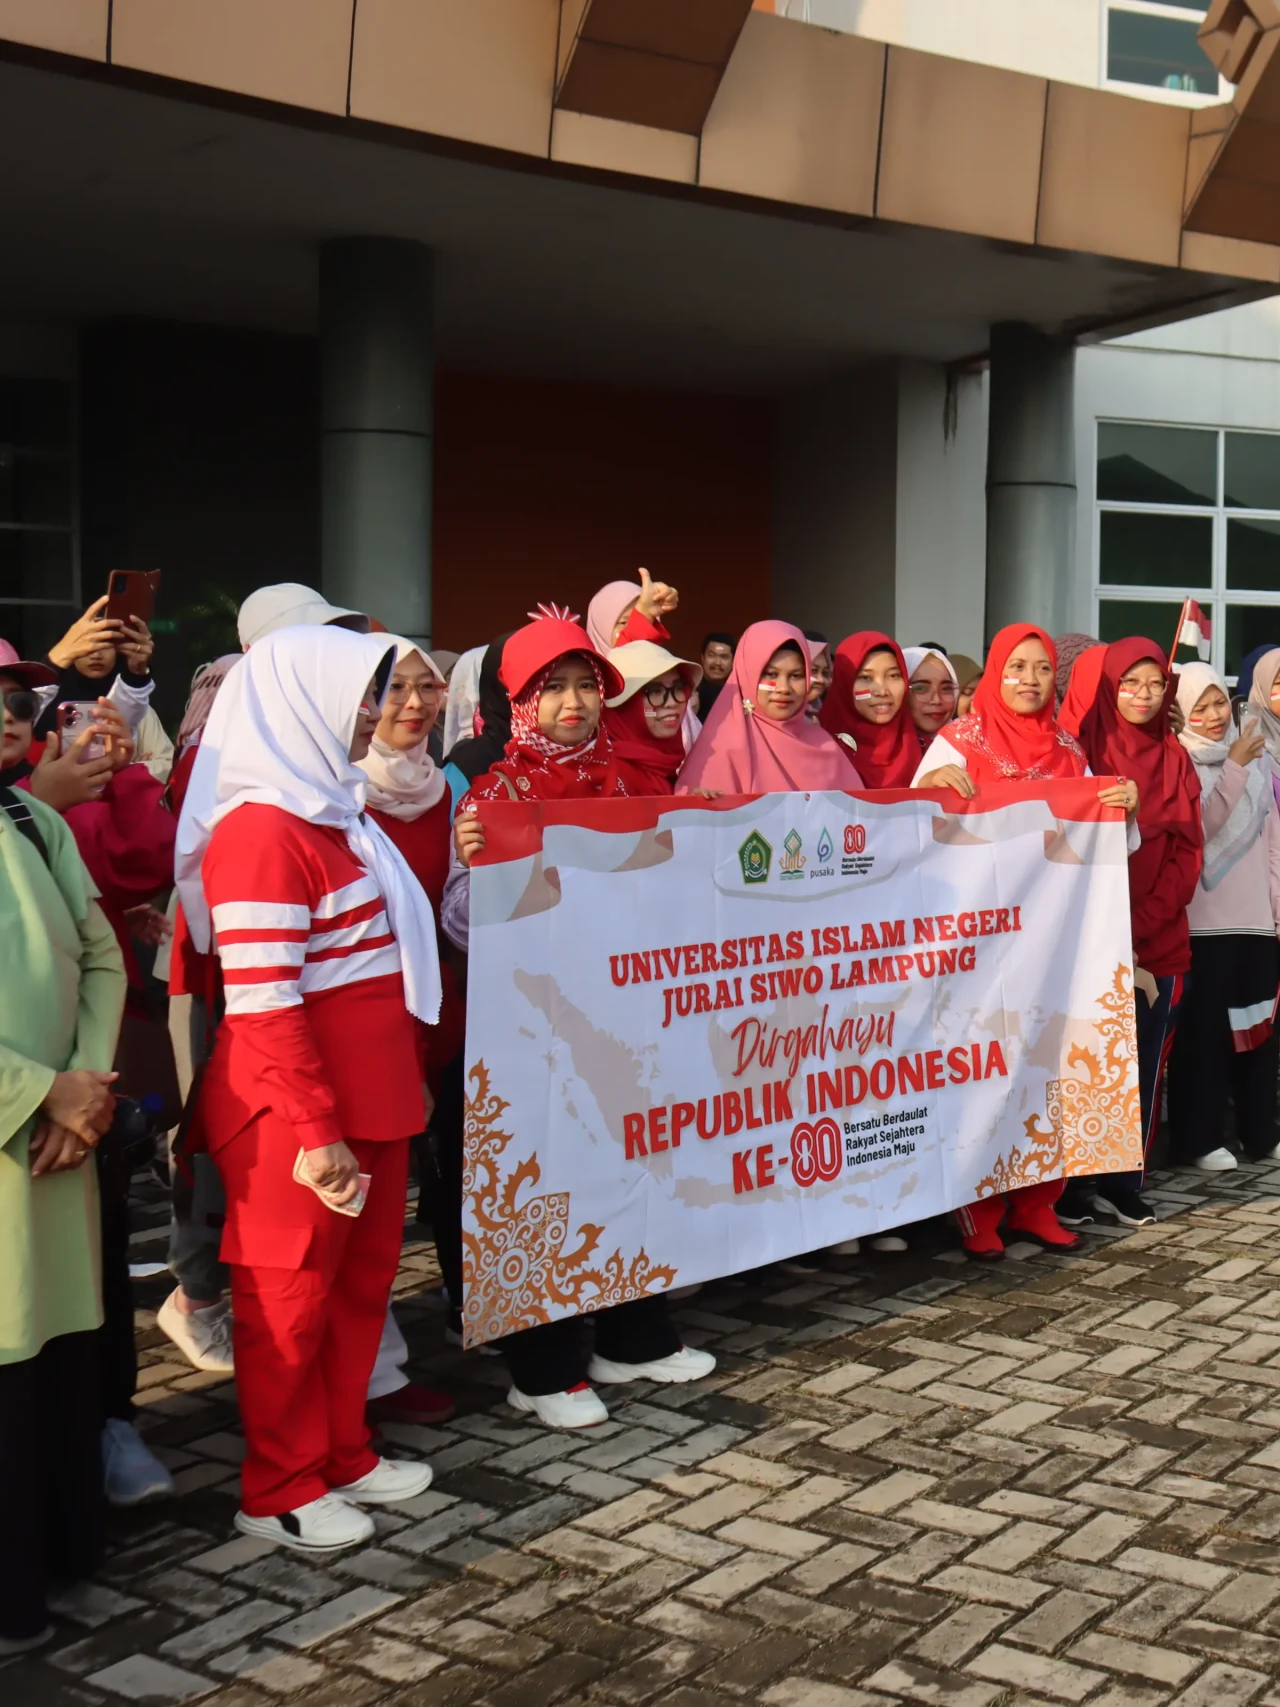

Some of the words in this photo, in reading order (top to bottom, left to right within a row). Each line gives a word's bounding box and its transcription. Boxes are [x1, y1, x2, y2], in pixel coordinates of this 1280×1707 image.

[844, 824, 866, 854] 80
[810, 867, 835, 879] pusaka
[609, 931, 805, 987] UNIVERSITAS
[811, 920, 905, 957] ISLAM
[913, 906, 1022, 944] NEGERI
[662, 977, 744, 1028] JURAI
[751, 965, 823, 1004] SIWO
[830, 945, 976, 990] LAMPUNG
[731, 1004, 895, 1078] Dirgahayu
[623, 1078, 793, 1160] REPUBLIK
[806, 1040, 1008, 1115] INDONESIA
[844, 1117, 881, 1135] Bersatu
[883, 1106, 928, 1126] Berdaulat
[845, 1133, 878, 1151] Rakyat
[879, 1124, 925, 1144] Sejahtera
[846, 1146, 892, 1167] Indonesia
[893, 1141, 916, 1156] Maju
